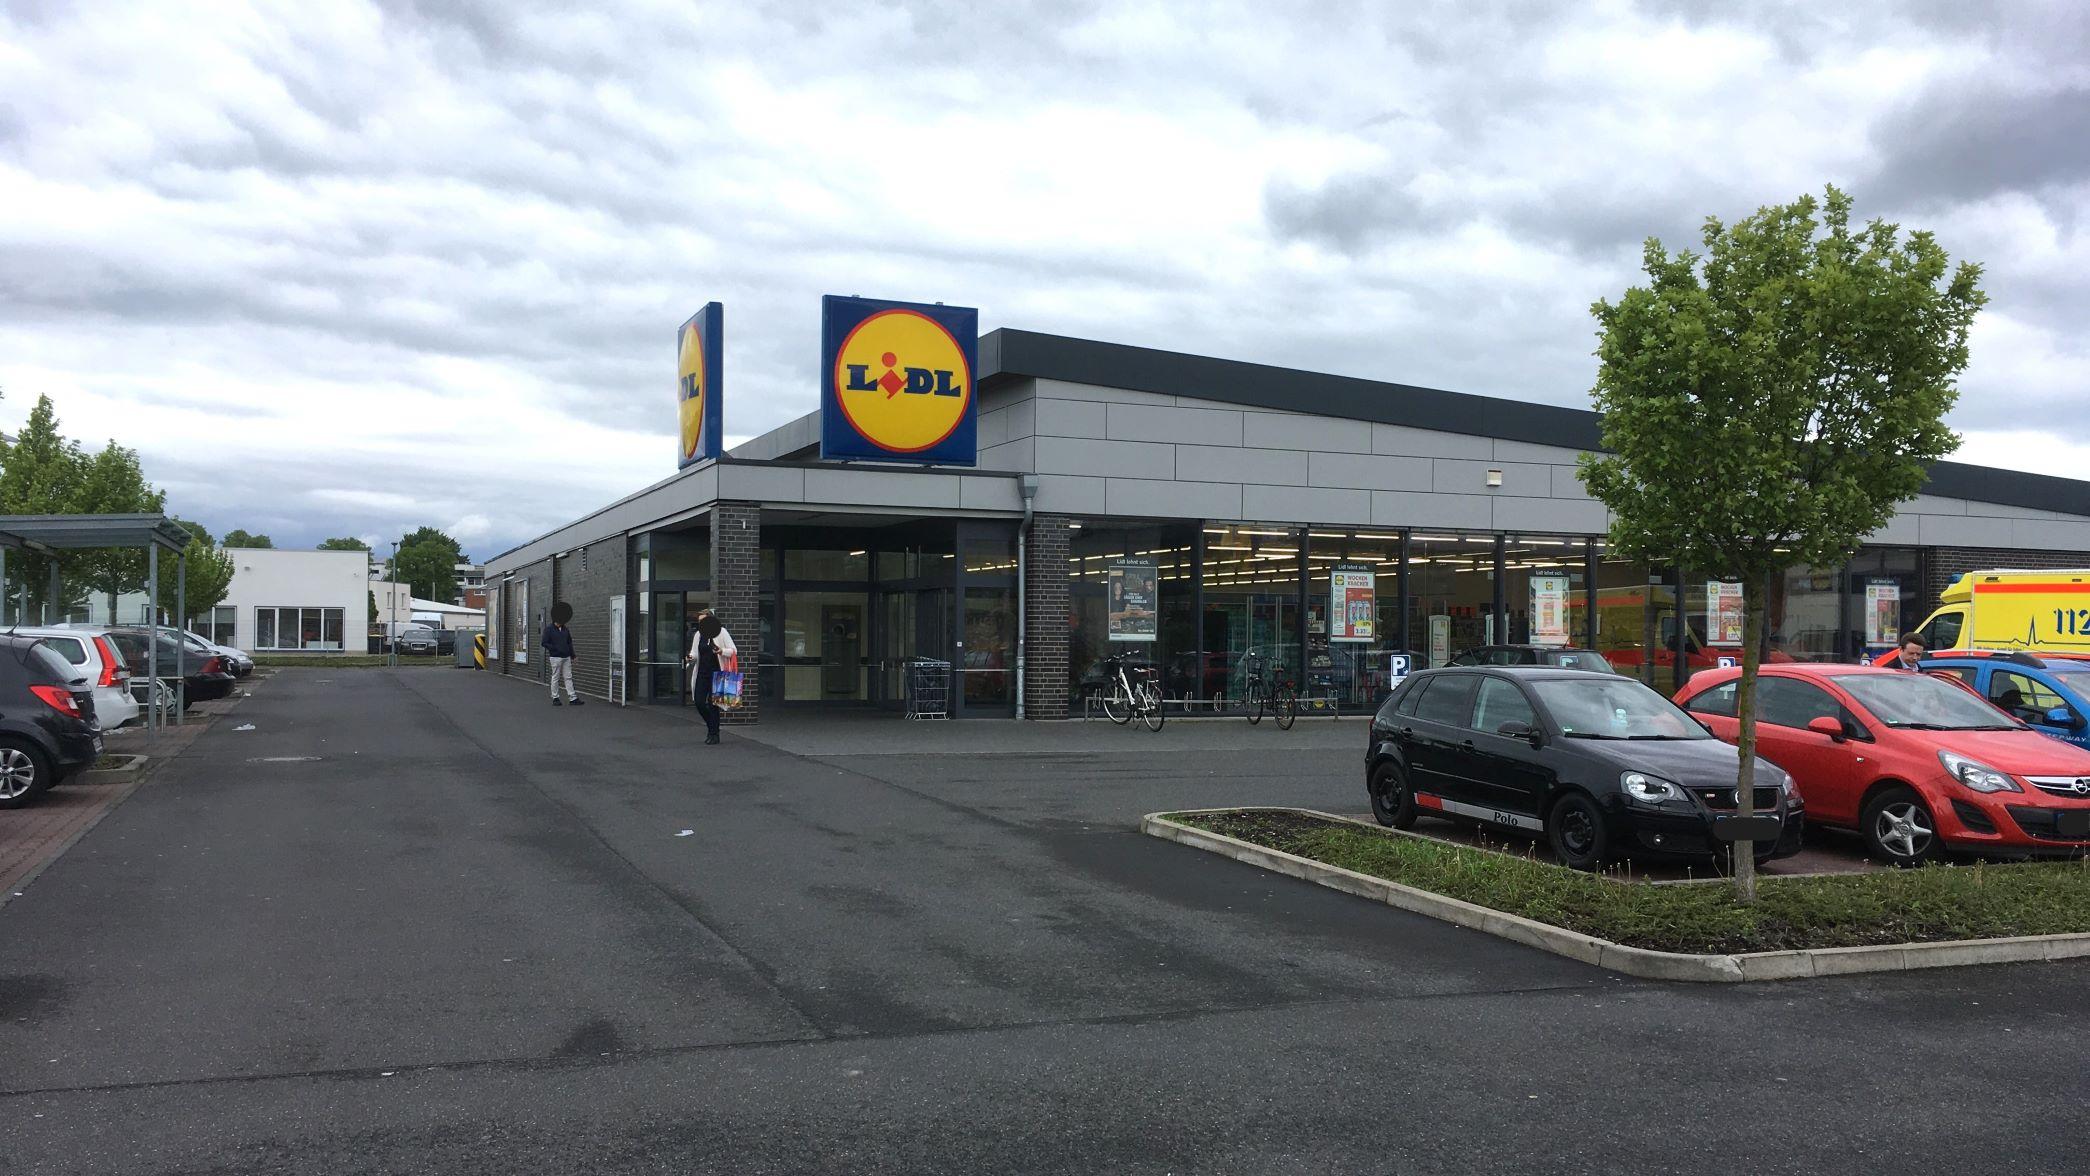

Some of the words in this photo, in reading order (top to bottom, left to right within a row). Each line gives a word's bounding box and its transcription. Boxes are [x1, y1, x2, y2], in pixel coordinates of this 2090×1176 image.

[681, 372, 700, 401] DL
[2053, 608, 2090, 635] 112
[1392, 656, 1406, 676] P
[1494, 812, 1518, 825] Polo
